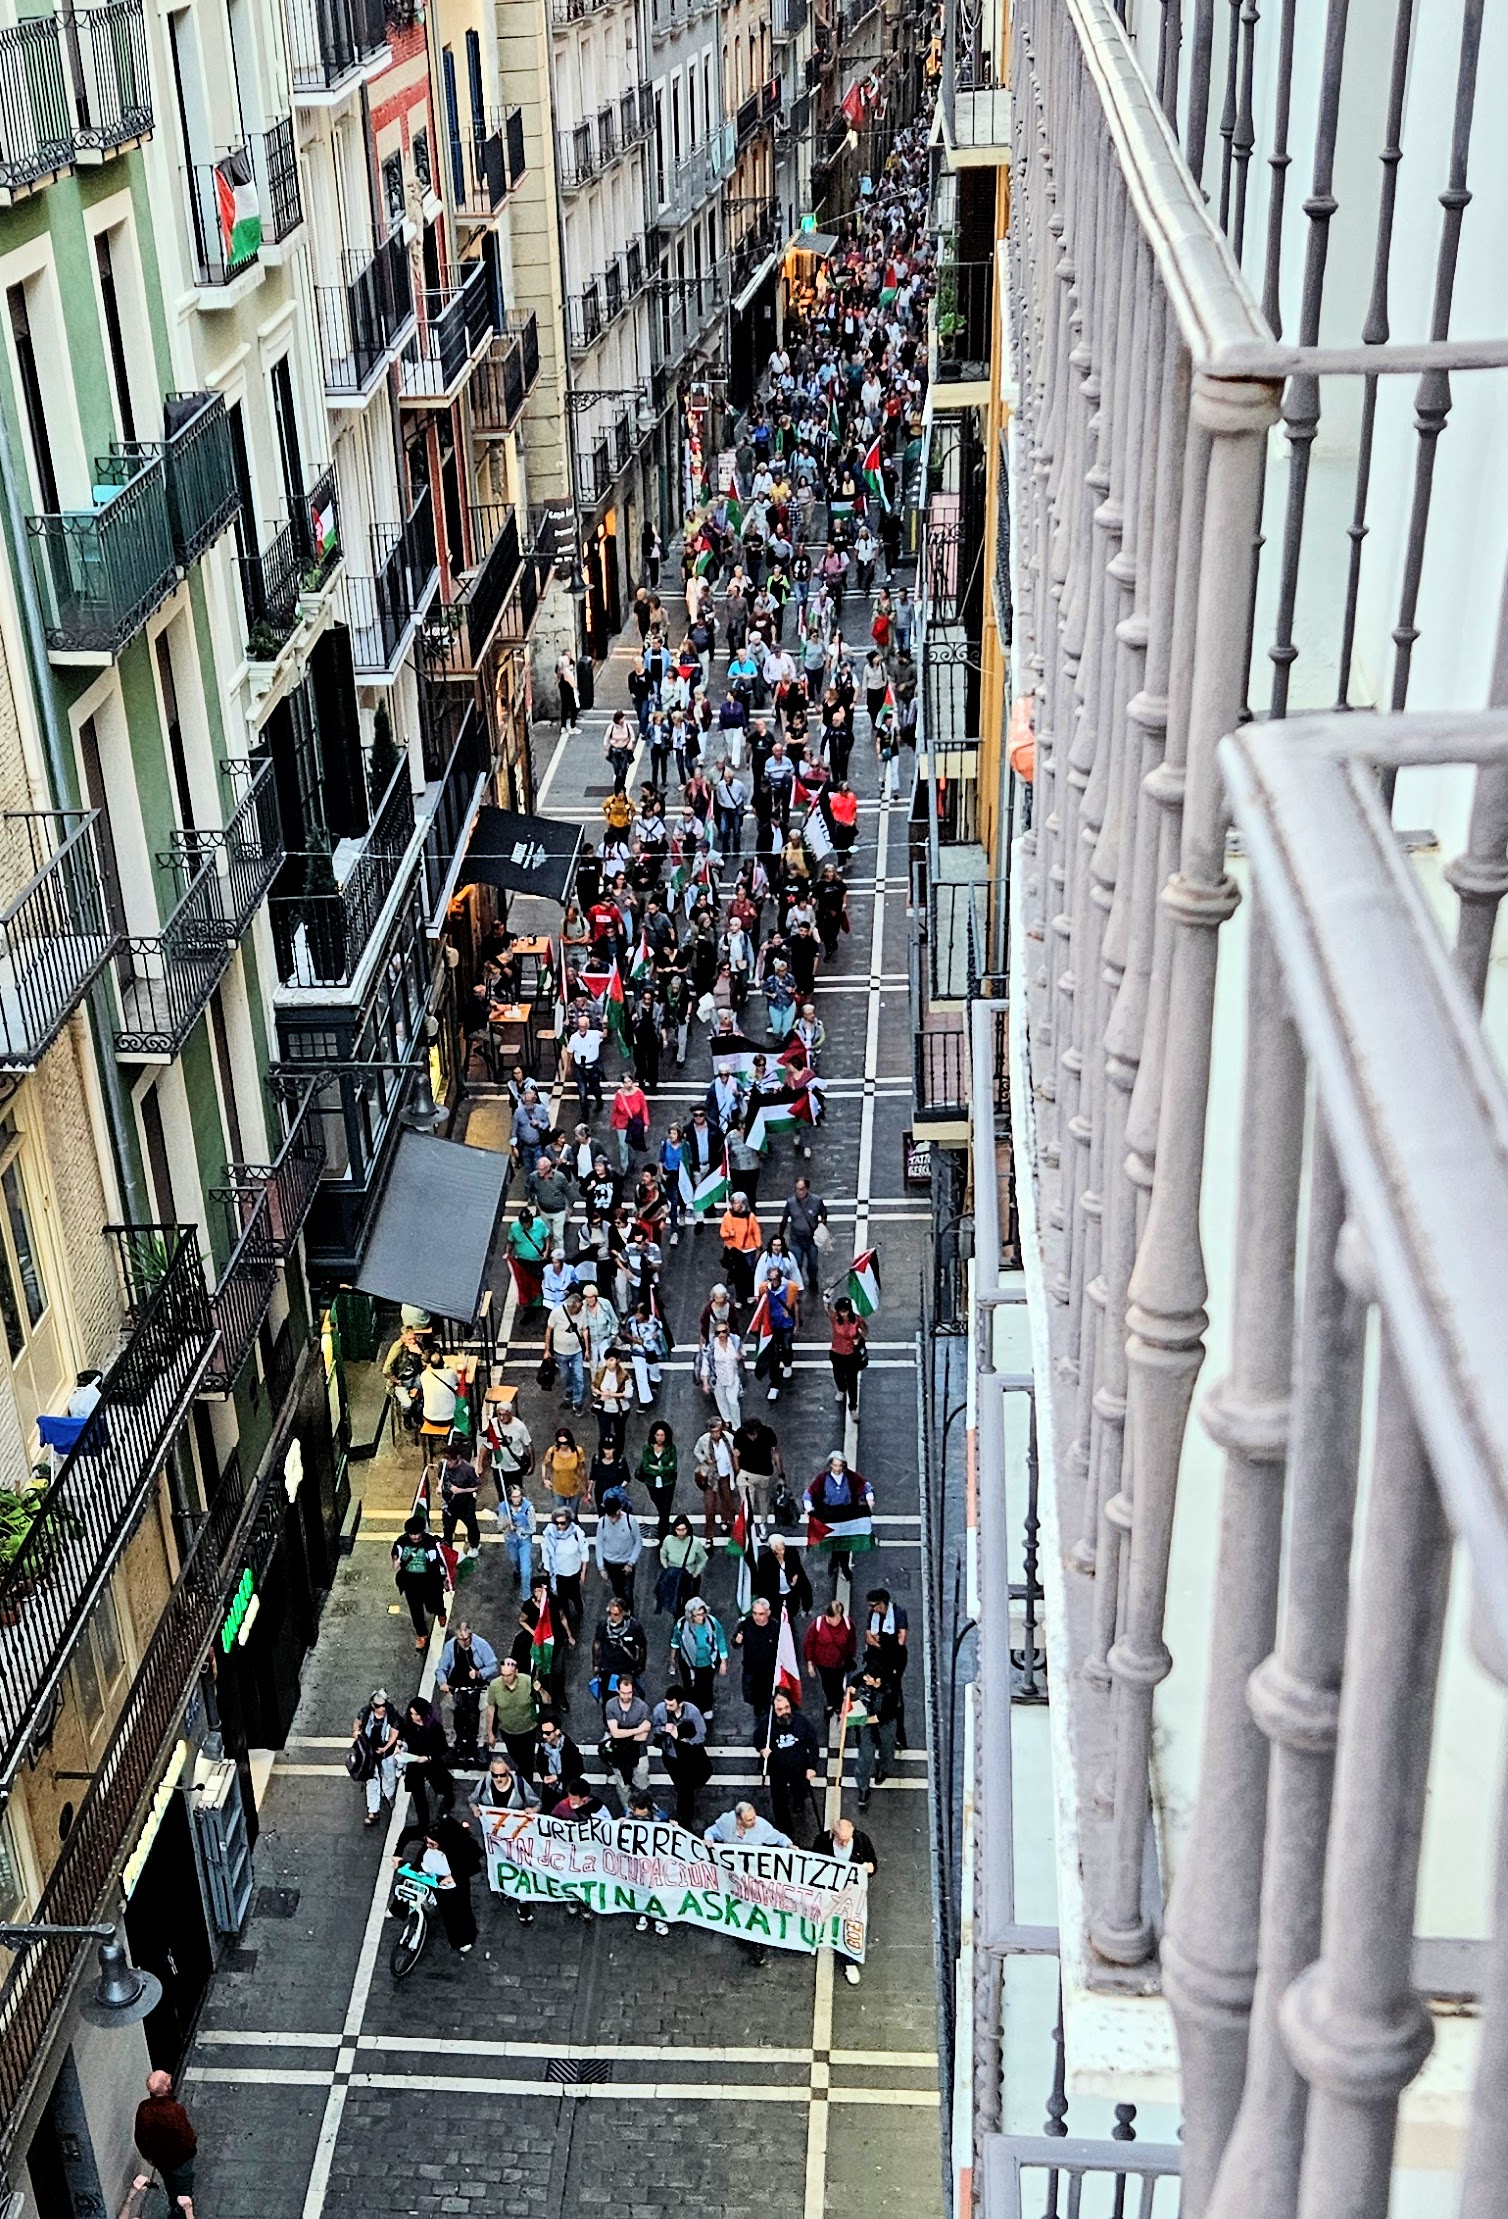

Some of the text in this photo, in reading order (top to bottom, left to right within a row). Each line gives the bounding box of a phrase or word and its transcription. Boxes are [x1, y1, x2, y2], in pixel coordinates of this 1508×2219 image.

[486, 1811, 536, 1839] 77
[486, 1832, 534, 1866] FIN
[537, 1840, 566, 1871] de
[496, 1862, 668, 1917] PALESTINA
